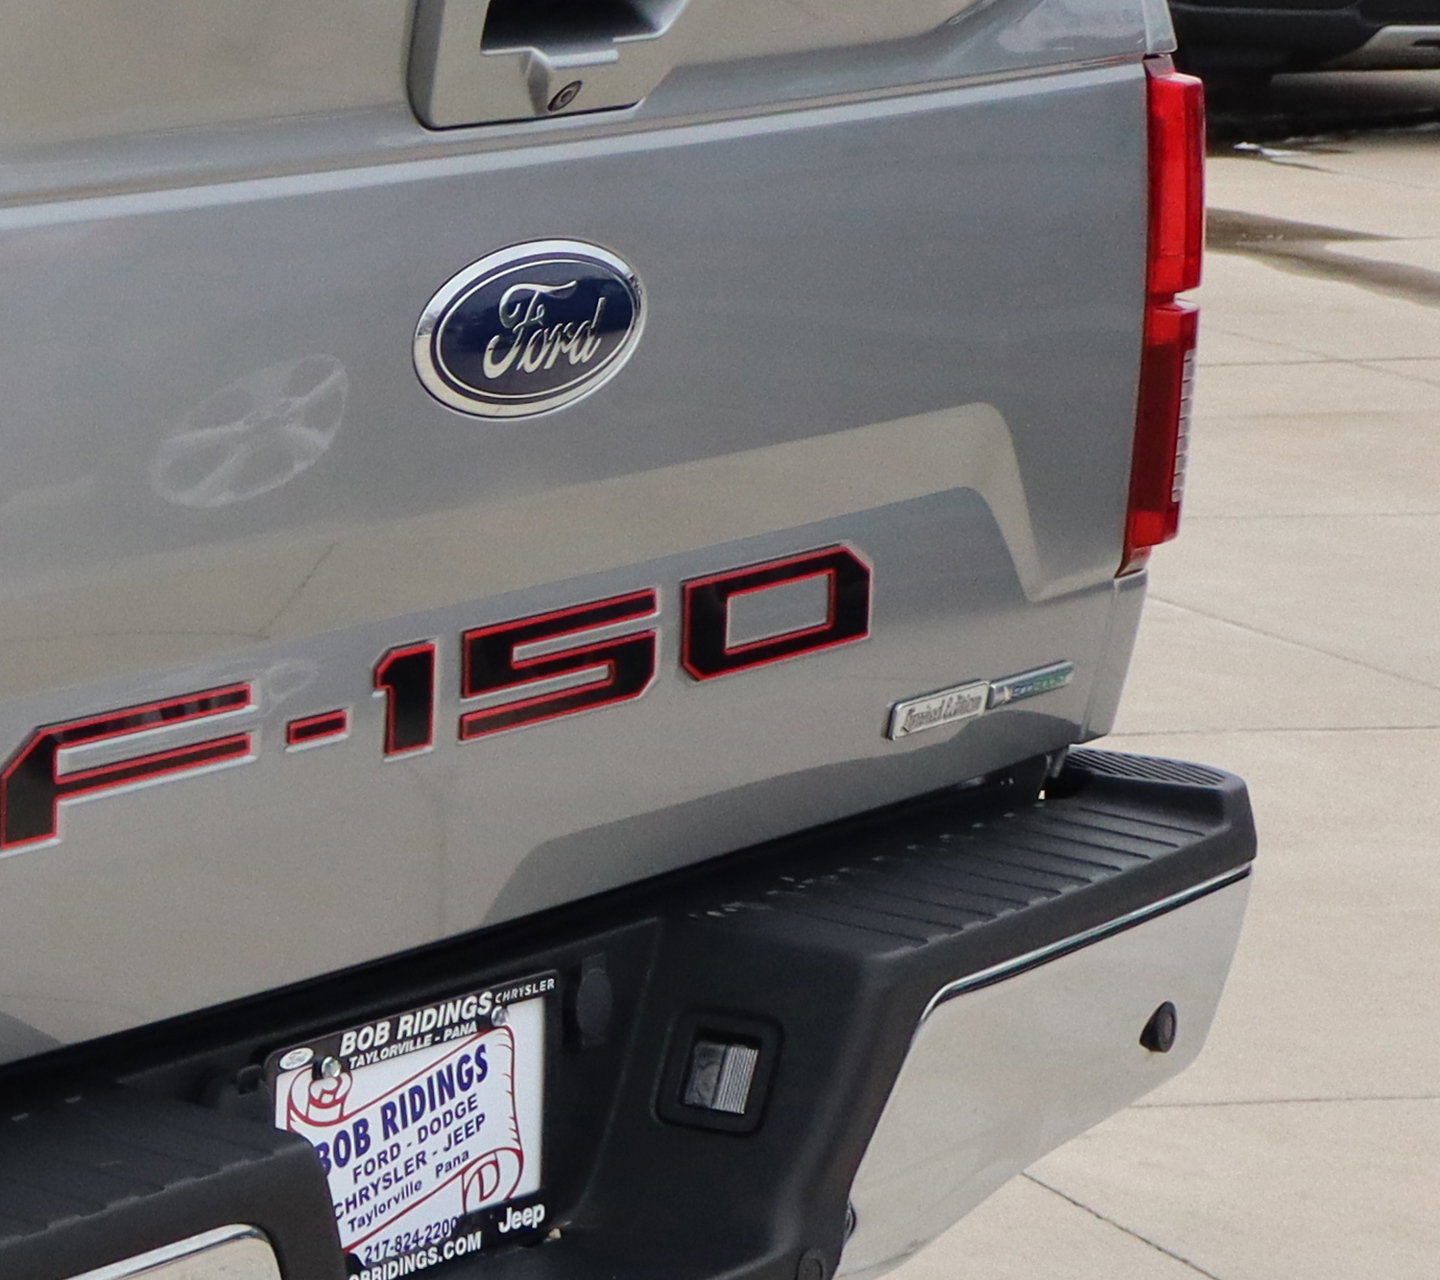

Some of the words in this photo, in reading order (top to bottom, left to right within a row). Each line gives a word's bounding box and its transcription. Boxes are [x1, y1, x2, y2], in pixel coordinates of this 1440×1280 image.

[483, 281, 608, 379] Ford
[339, 1021, 390, 1058] BOB
[396, 991, 493, 1040] RIDINGS
[495, 978, 556, 1004] CHRYSLER
[349, 1033, 433, 1070] TAYLORVILLE
[442, 1021, 478, 1043] PANA
[314, 1118, 371, 1177] BOB
[380, 1044, 490, 1141] RIDINGS
[352, 1140, 400, 1185] FORD
[417, 1093, 479, 1145] DODGE
[333, 1151, 428, 1222] CHRYSLER
[443, 1113, 487, 1160] JEEP
[347, 1179, 423, 1233] Taylorville
[435, 1149, 470, 1179] Pana
[498, 1203, 545, 1234] Jeep
